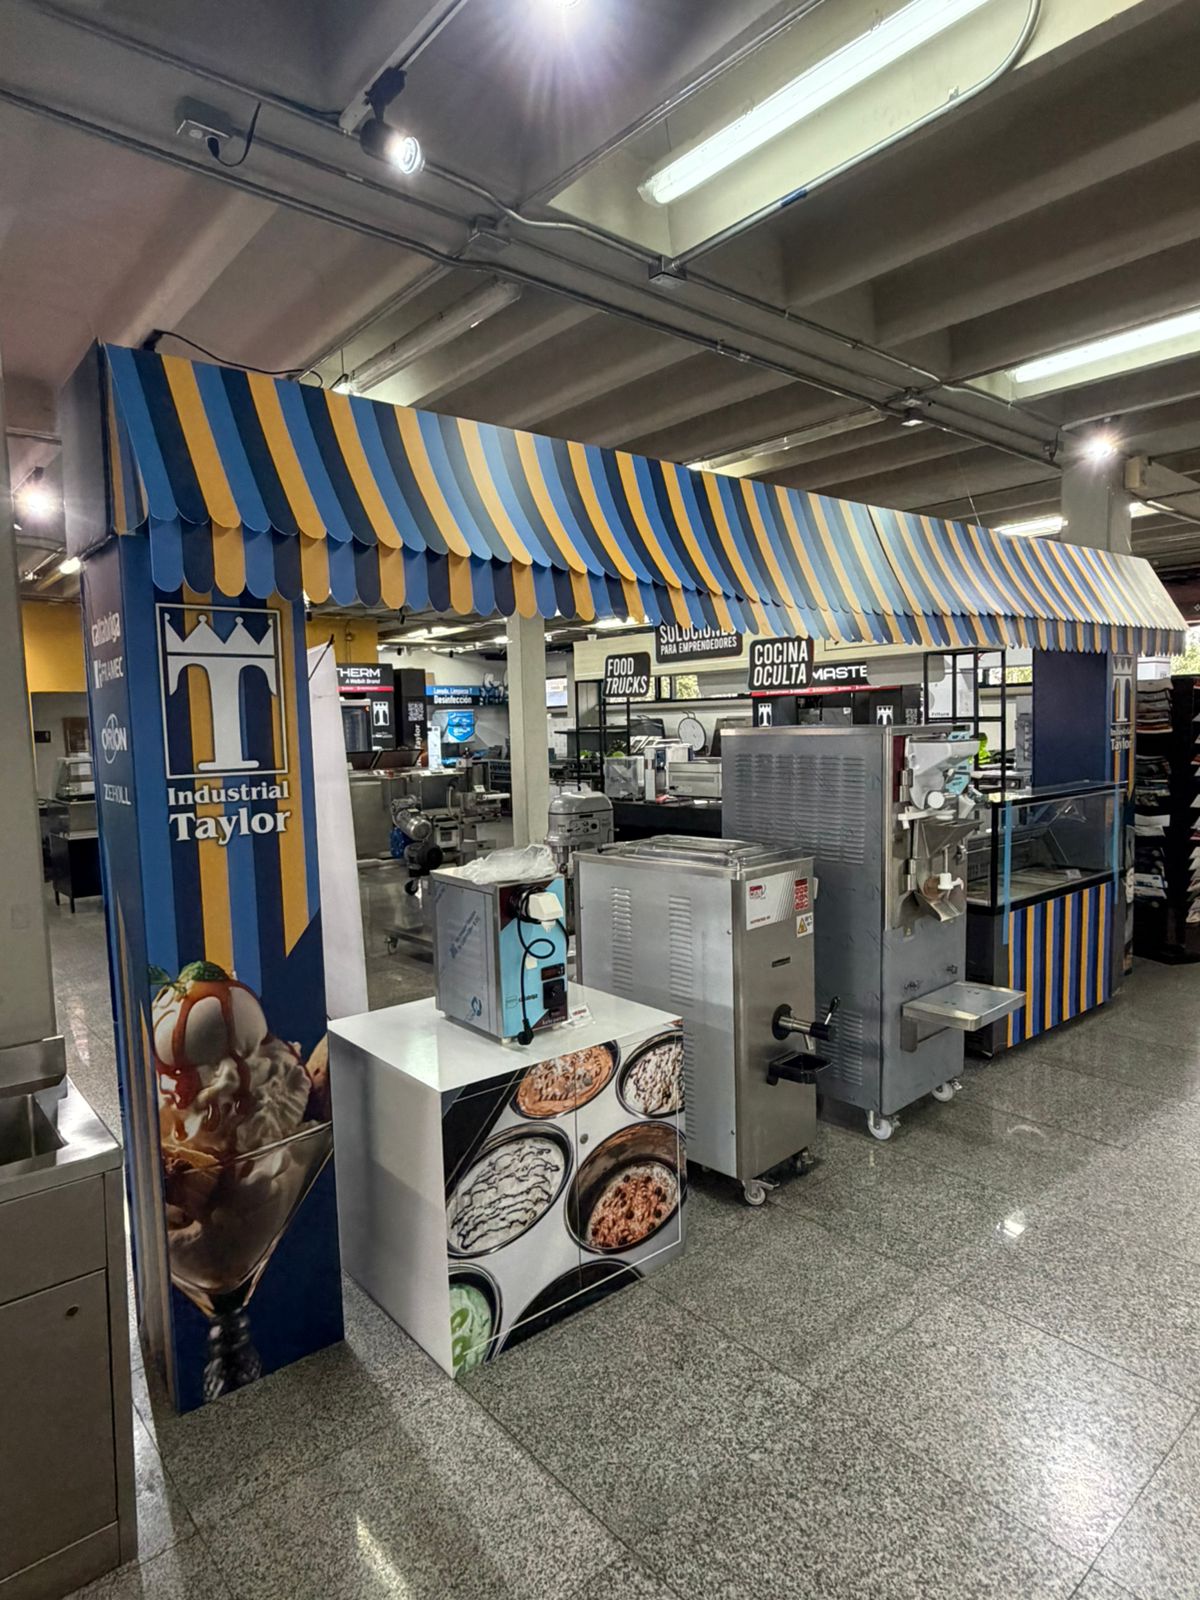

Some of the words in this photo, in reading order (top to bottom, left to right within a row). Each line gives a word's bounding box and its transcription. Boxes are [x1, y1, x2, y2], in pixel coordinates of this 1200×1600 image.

[659, 622, 737, 644] SOLUCIONS
[660, 642, 677, 656] PARA
[679, 636, 737, 653] EMPRENDEDORES
[754, 640, 809, 666] COCINA
[607, 656, 635, 677] FOOD
[753, 663, 807, 687] OCULTA
[605, 675, 648, 695] TRUCKS
[101, 727, 127, 752] ORION
[167, 780, 290, 806] Industrial
[168, 807, 291, 845] Taylor
